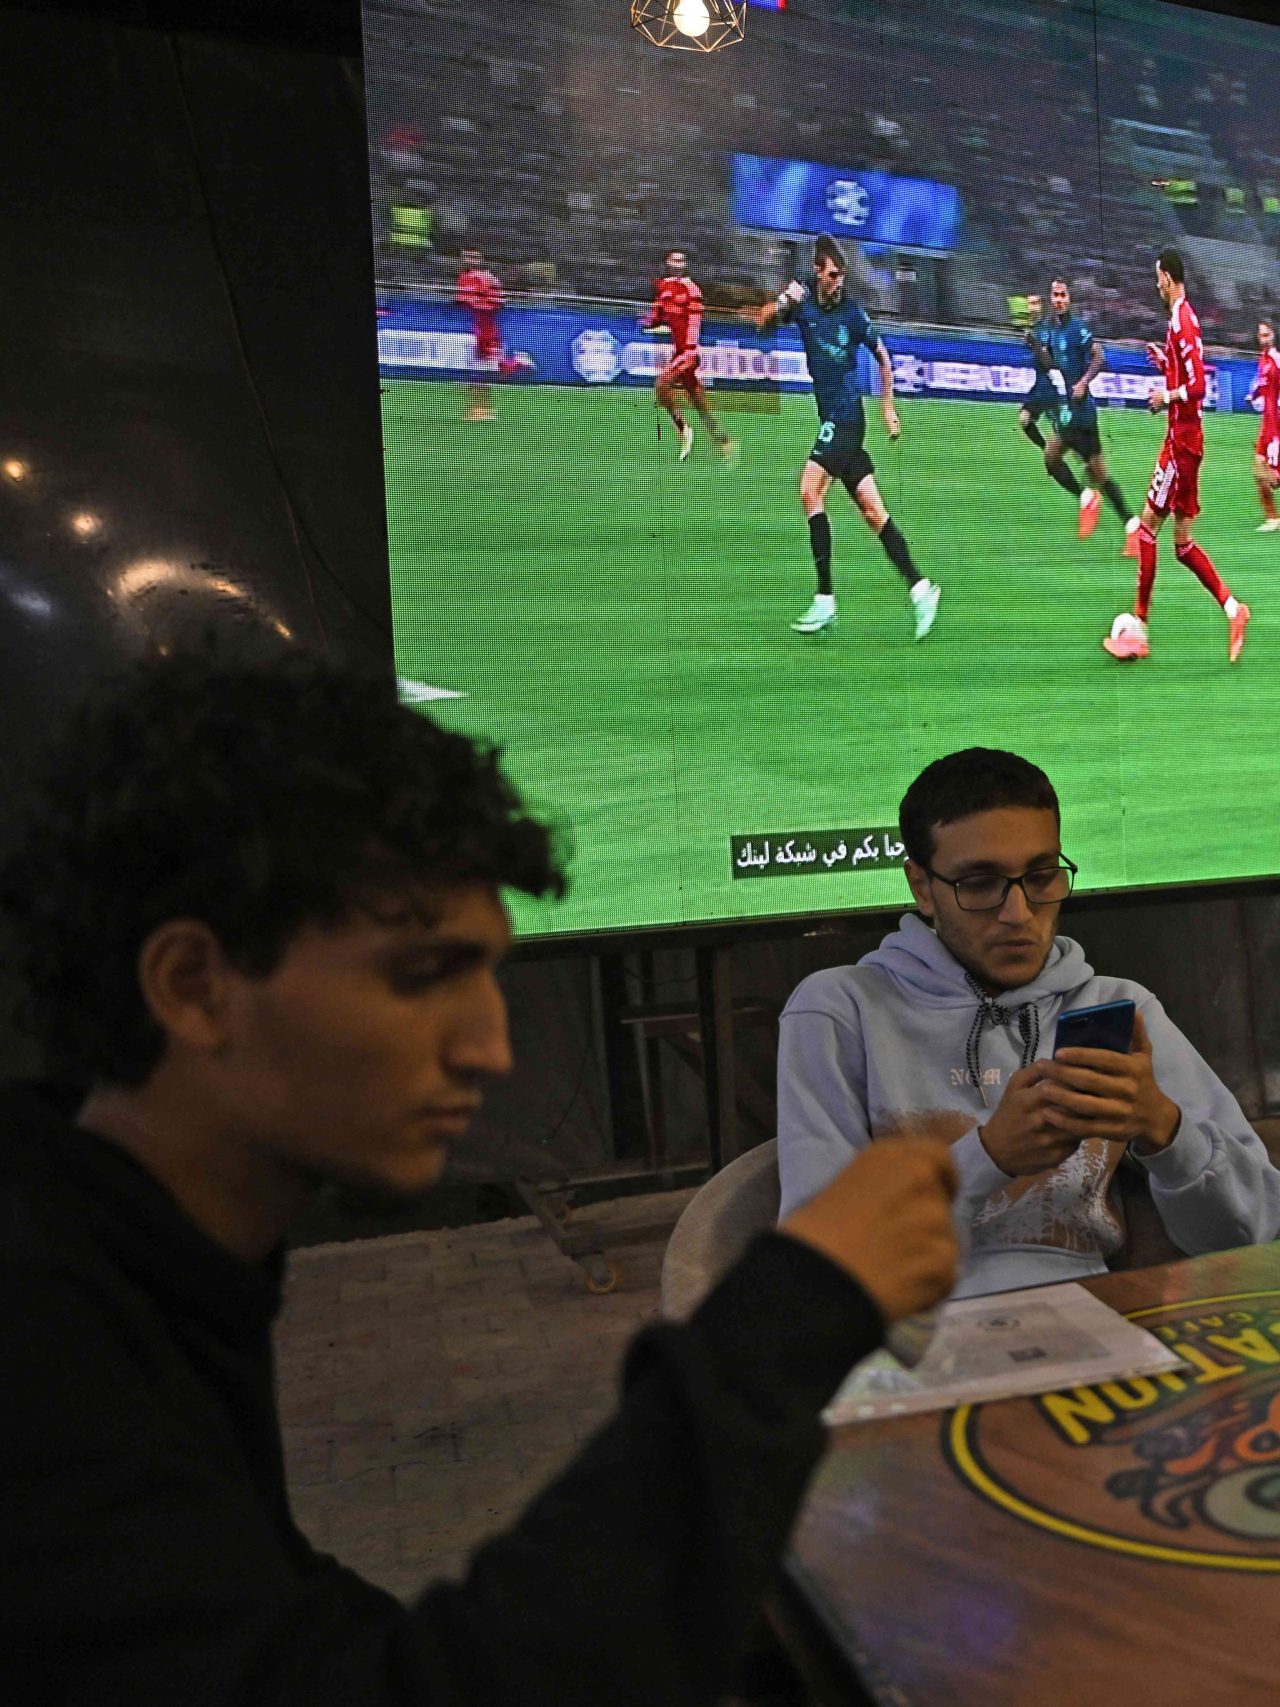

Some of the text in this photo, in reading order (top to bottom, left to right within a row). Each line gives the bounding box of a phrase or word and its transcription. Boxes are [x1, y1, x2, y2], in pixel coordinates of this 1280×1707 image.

[775, 840, 817, 867] شبكة
[822, 840, 847, 868] في
[852, 834, 879, 866] بكم
